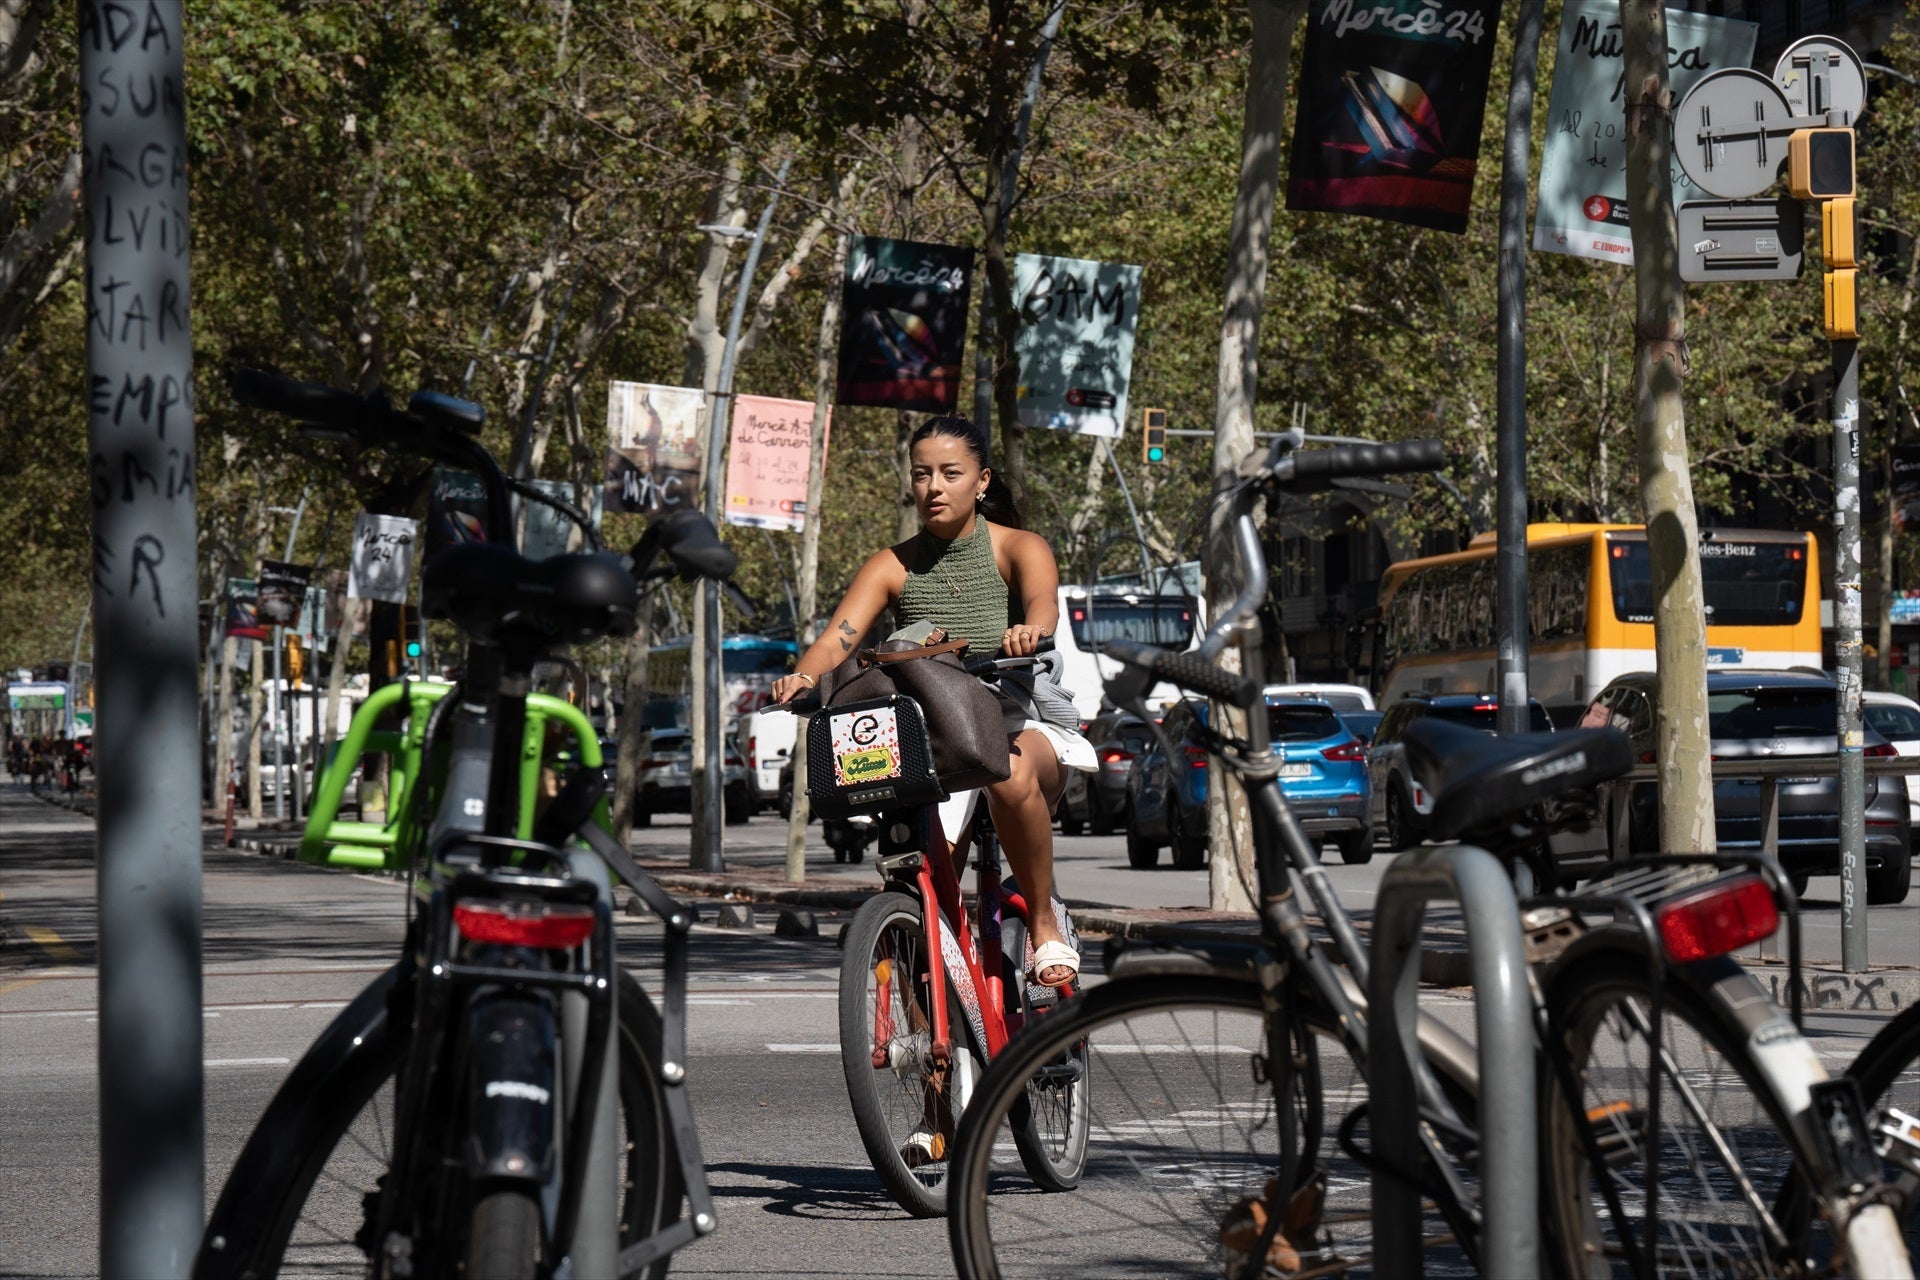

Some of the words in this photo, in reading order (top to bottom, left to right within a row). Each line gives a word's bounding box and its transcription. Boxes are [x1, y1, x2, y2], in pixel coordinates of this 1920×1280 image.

[1023, 268, 1125, 327] BAM
[622, 469, 683, 511] MAC
[371, 546, 393, 564] 24
